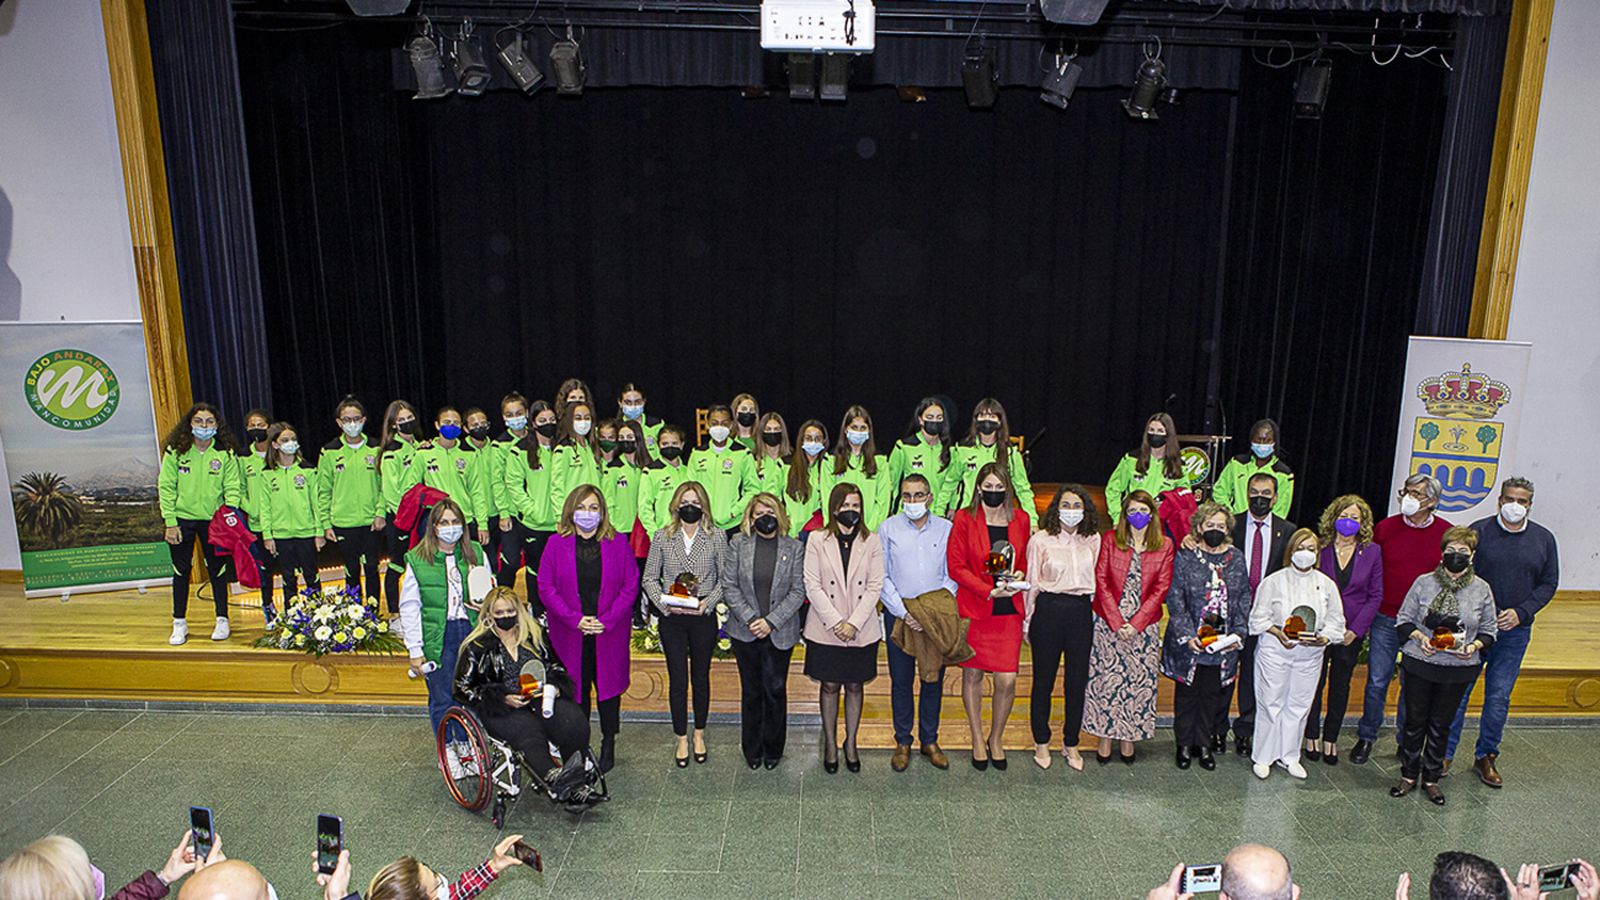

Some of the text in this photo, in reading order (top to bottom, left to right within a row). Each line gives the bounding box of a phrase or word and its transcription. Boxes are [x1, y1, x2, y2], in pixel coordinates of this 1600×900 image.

[27, 351, 115, 386] BAJO ANDARAX
[30, 391, 117, 428] MANCOMUNIDAD
